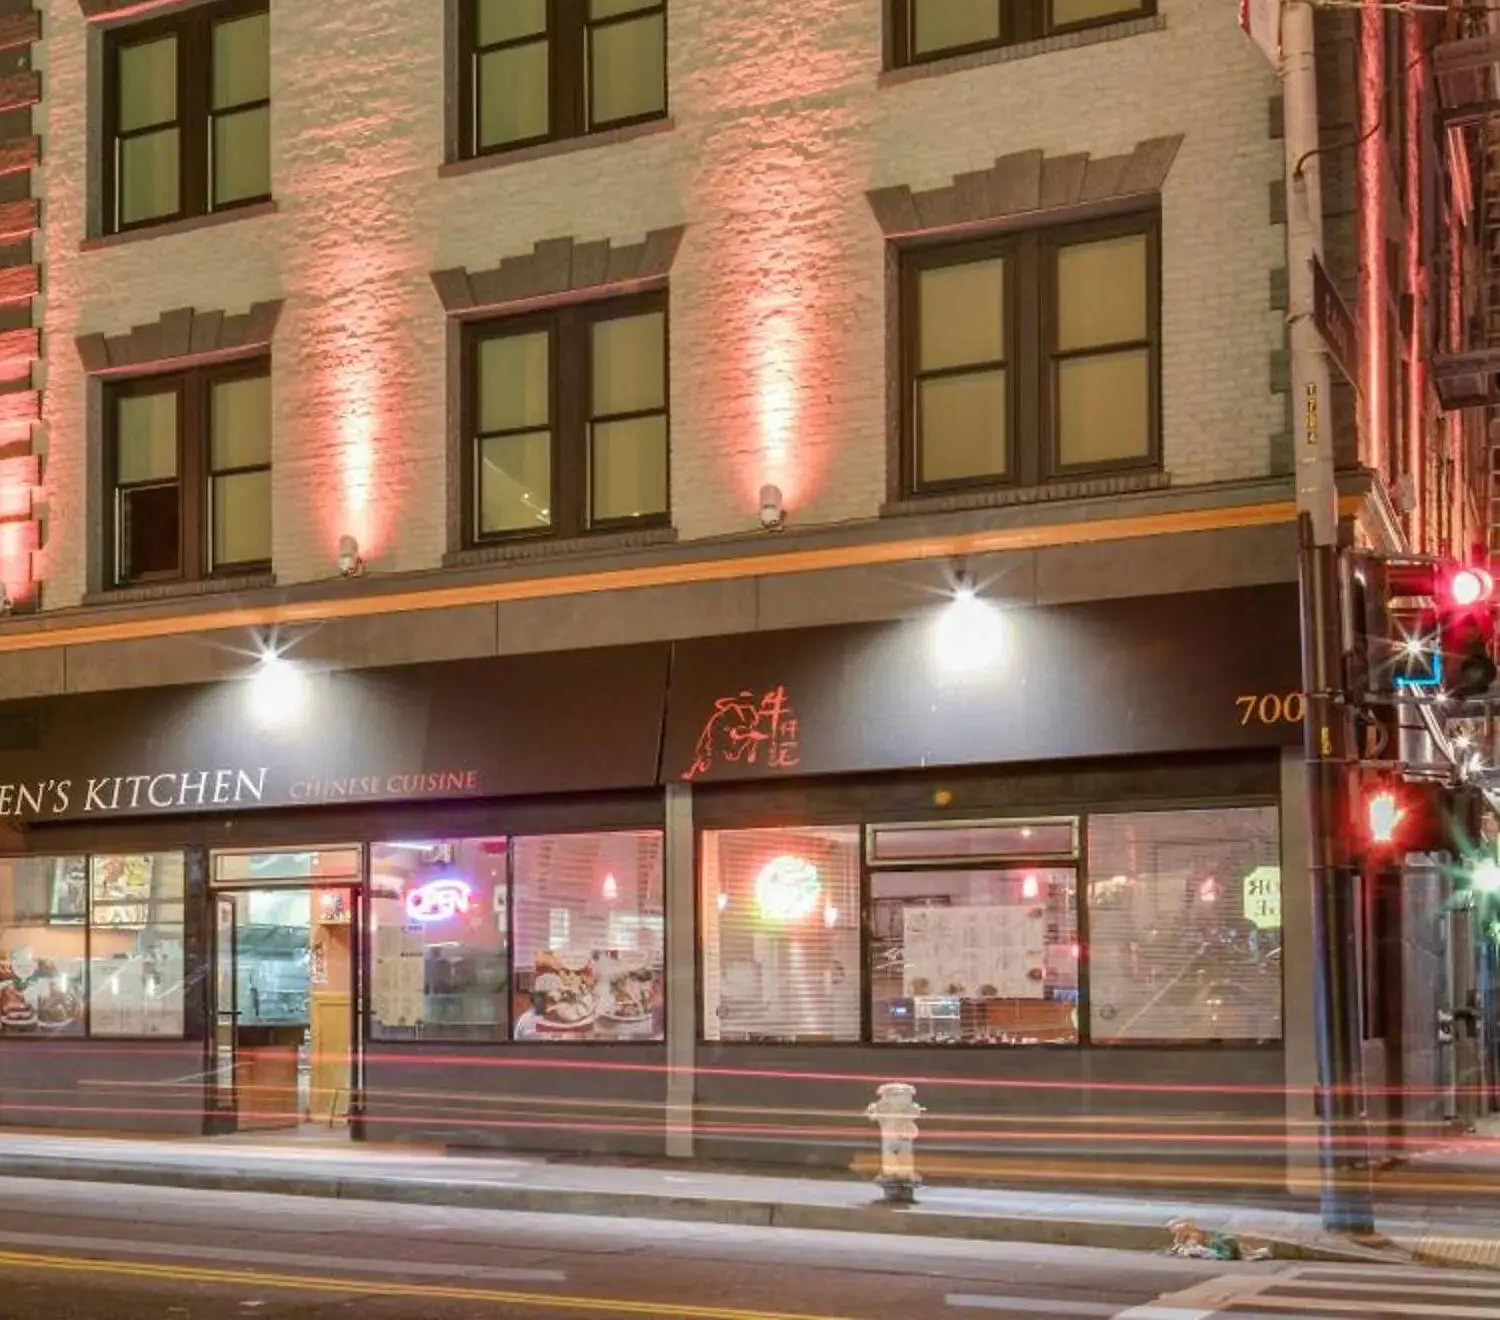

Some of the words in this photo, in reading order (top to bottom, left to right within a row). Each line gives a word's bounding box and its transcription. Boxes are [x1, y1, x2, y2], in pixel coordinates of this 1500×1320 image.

[1235, 693, 1305, 726] 700
[83, 767, 267, 811] KITCHEN
[289, 776, 381, 798] CHINESE
[386, 770, 478, 792] CUISINE
